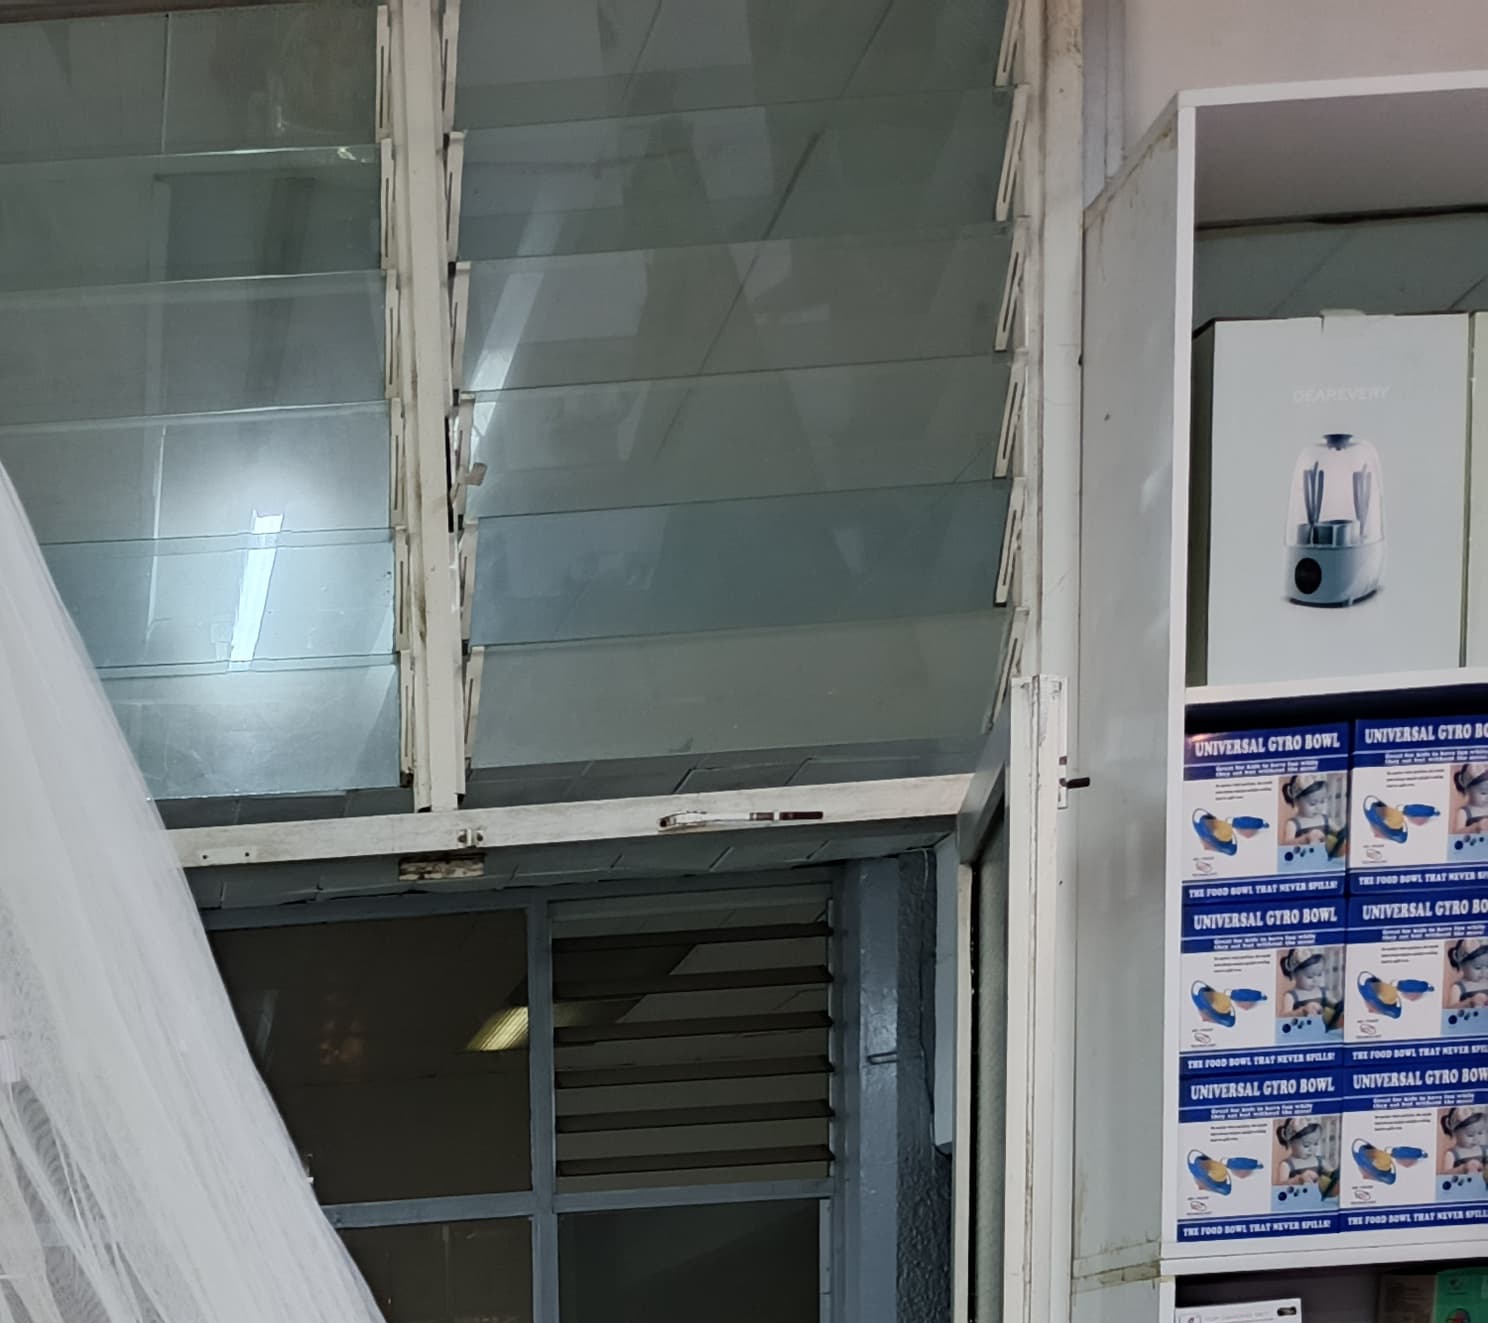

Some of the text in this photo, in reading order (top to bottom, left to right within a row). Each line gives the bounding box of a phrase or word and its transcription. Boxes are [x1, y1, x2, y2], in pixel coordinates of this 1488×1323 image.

[1365, 726, 1435, 744] UNIVERSAL
[1438, 724, 1472, 740] GYRO
[1195, 732, 1340, 757] UNIVERSAL GYRO BOWL
[1359, 877, 1374, 885] THE
[1376, 875, 1398, 884] FOOD
[1425, 873, 1447, 882] THAT
[1448, 872, 1475, 881] NEVER
[1189, 889, 1204, 898] THE
[1207, 888, 1229, 896] FOOD
[1256, 884, 1277, 893] THAT
[1279, 882, 1306, 892] NEVER
[1194, 907, 1338, 929] UNIVERSAL GYRO BOWL
[1362, 901, 1432, 920] UNIVERSAL
[1435, 899, 1469, 916] GYRO
[1188, 1060, 1203, 1069] THE
[1205, 1059, 1227, 1068] FOOD
[1254, 1055, 1275, 1065] THAT
[1277, 1053, 1304, 1063] NEVER
[1352, 1052, 1368, 1060] THE
[1370, 1050, 1392, 1059] FOOD
[1419, 1047, 1441, 1057] THAT
[1442, 1046, 1469, 1055] NEVER
[1353, 1071, 1423, 1089] UNIVERSAL
[1425, 1069, 1459, 1084] GYRO
[1190, 1077, 1335, 1100] UNIVERSAL GYRO BOWL
[1348, 1217, 1363, 1225] THE
[1365, 1215, 1387, 1224] FOOD
[1413, 1212, 1435, 1222] THAT
[1437, 1211, 1464, 1220] NEVER
[1183, 1228, 1199, 1236] THE
[1201, 1226, 1223, 1235] FOOD
[1249, 1223, 1271, 1232] THAT
[1273, 1221, 1300, 1231] NEVER
